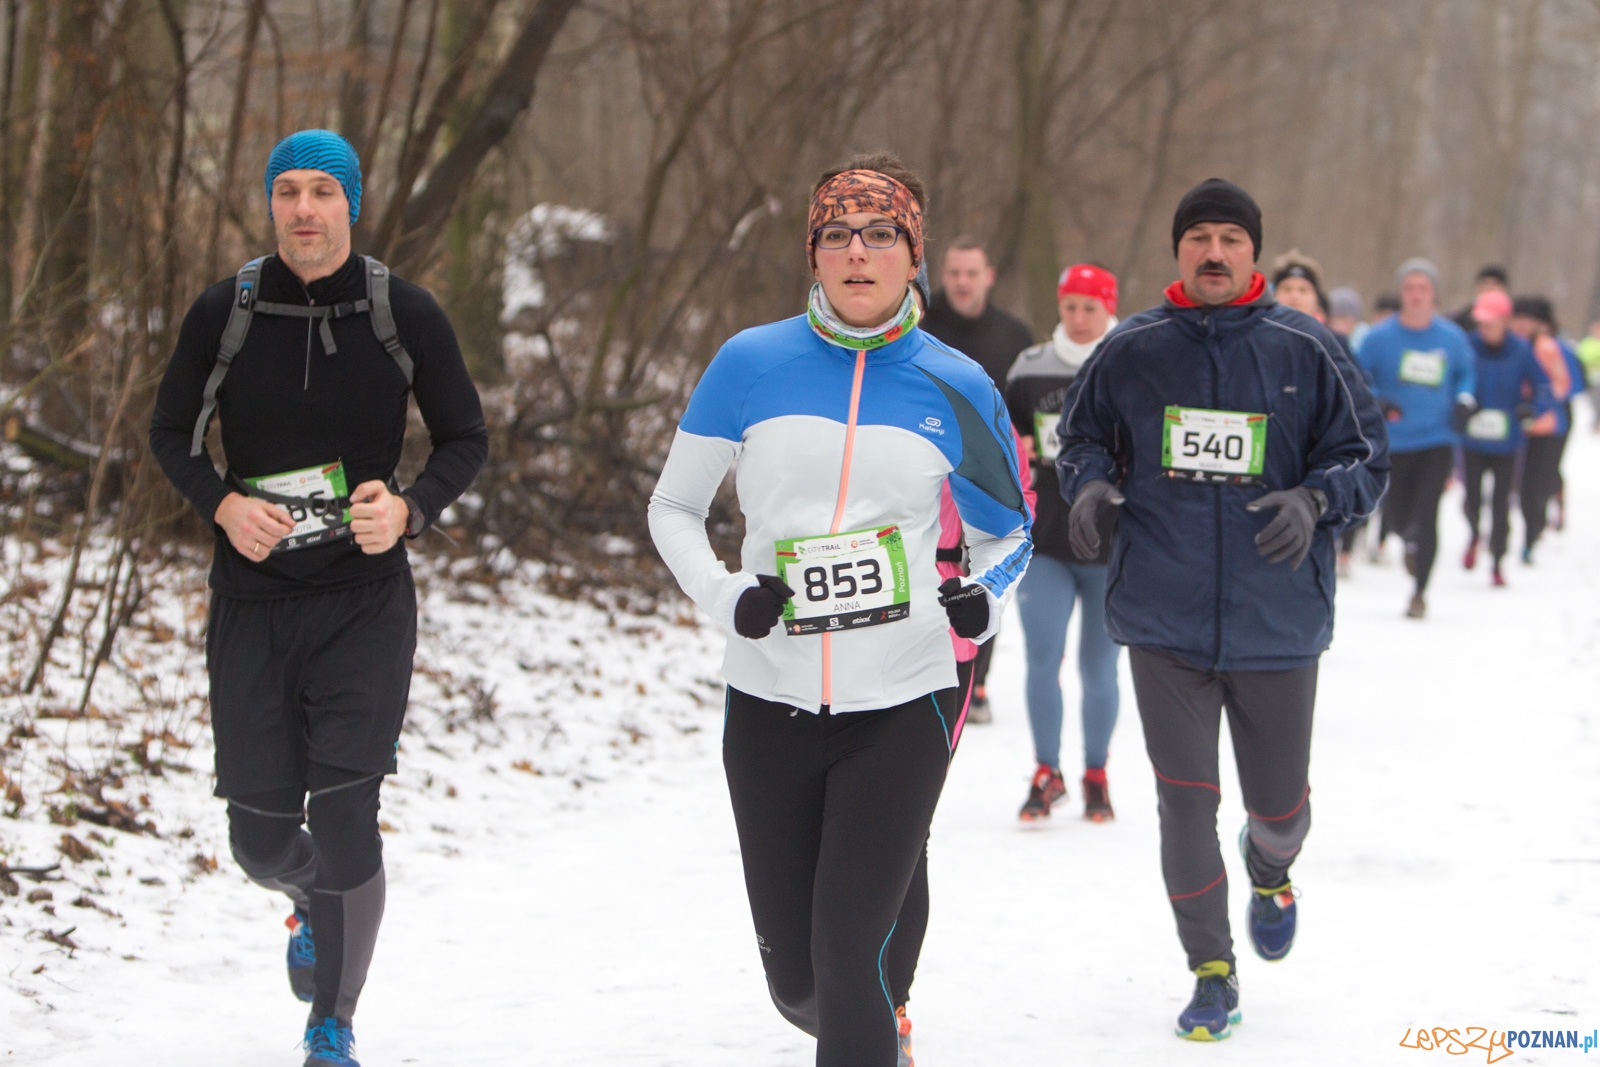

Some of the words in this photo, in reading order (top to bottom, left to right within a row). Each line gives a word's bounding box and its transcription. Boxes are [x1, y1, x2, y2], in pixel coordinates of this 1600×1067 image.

[919, 423, 945, 436] Kalenji
[1183, 431, 1243, 460] 540
[286, 490, 325, 522] 86
[804, 558, 883, 602] 853
[898, 562, 906, 592] Poznań
[833, 601, 861, 612] ANNA
